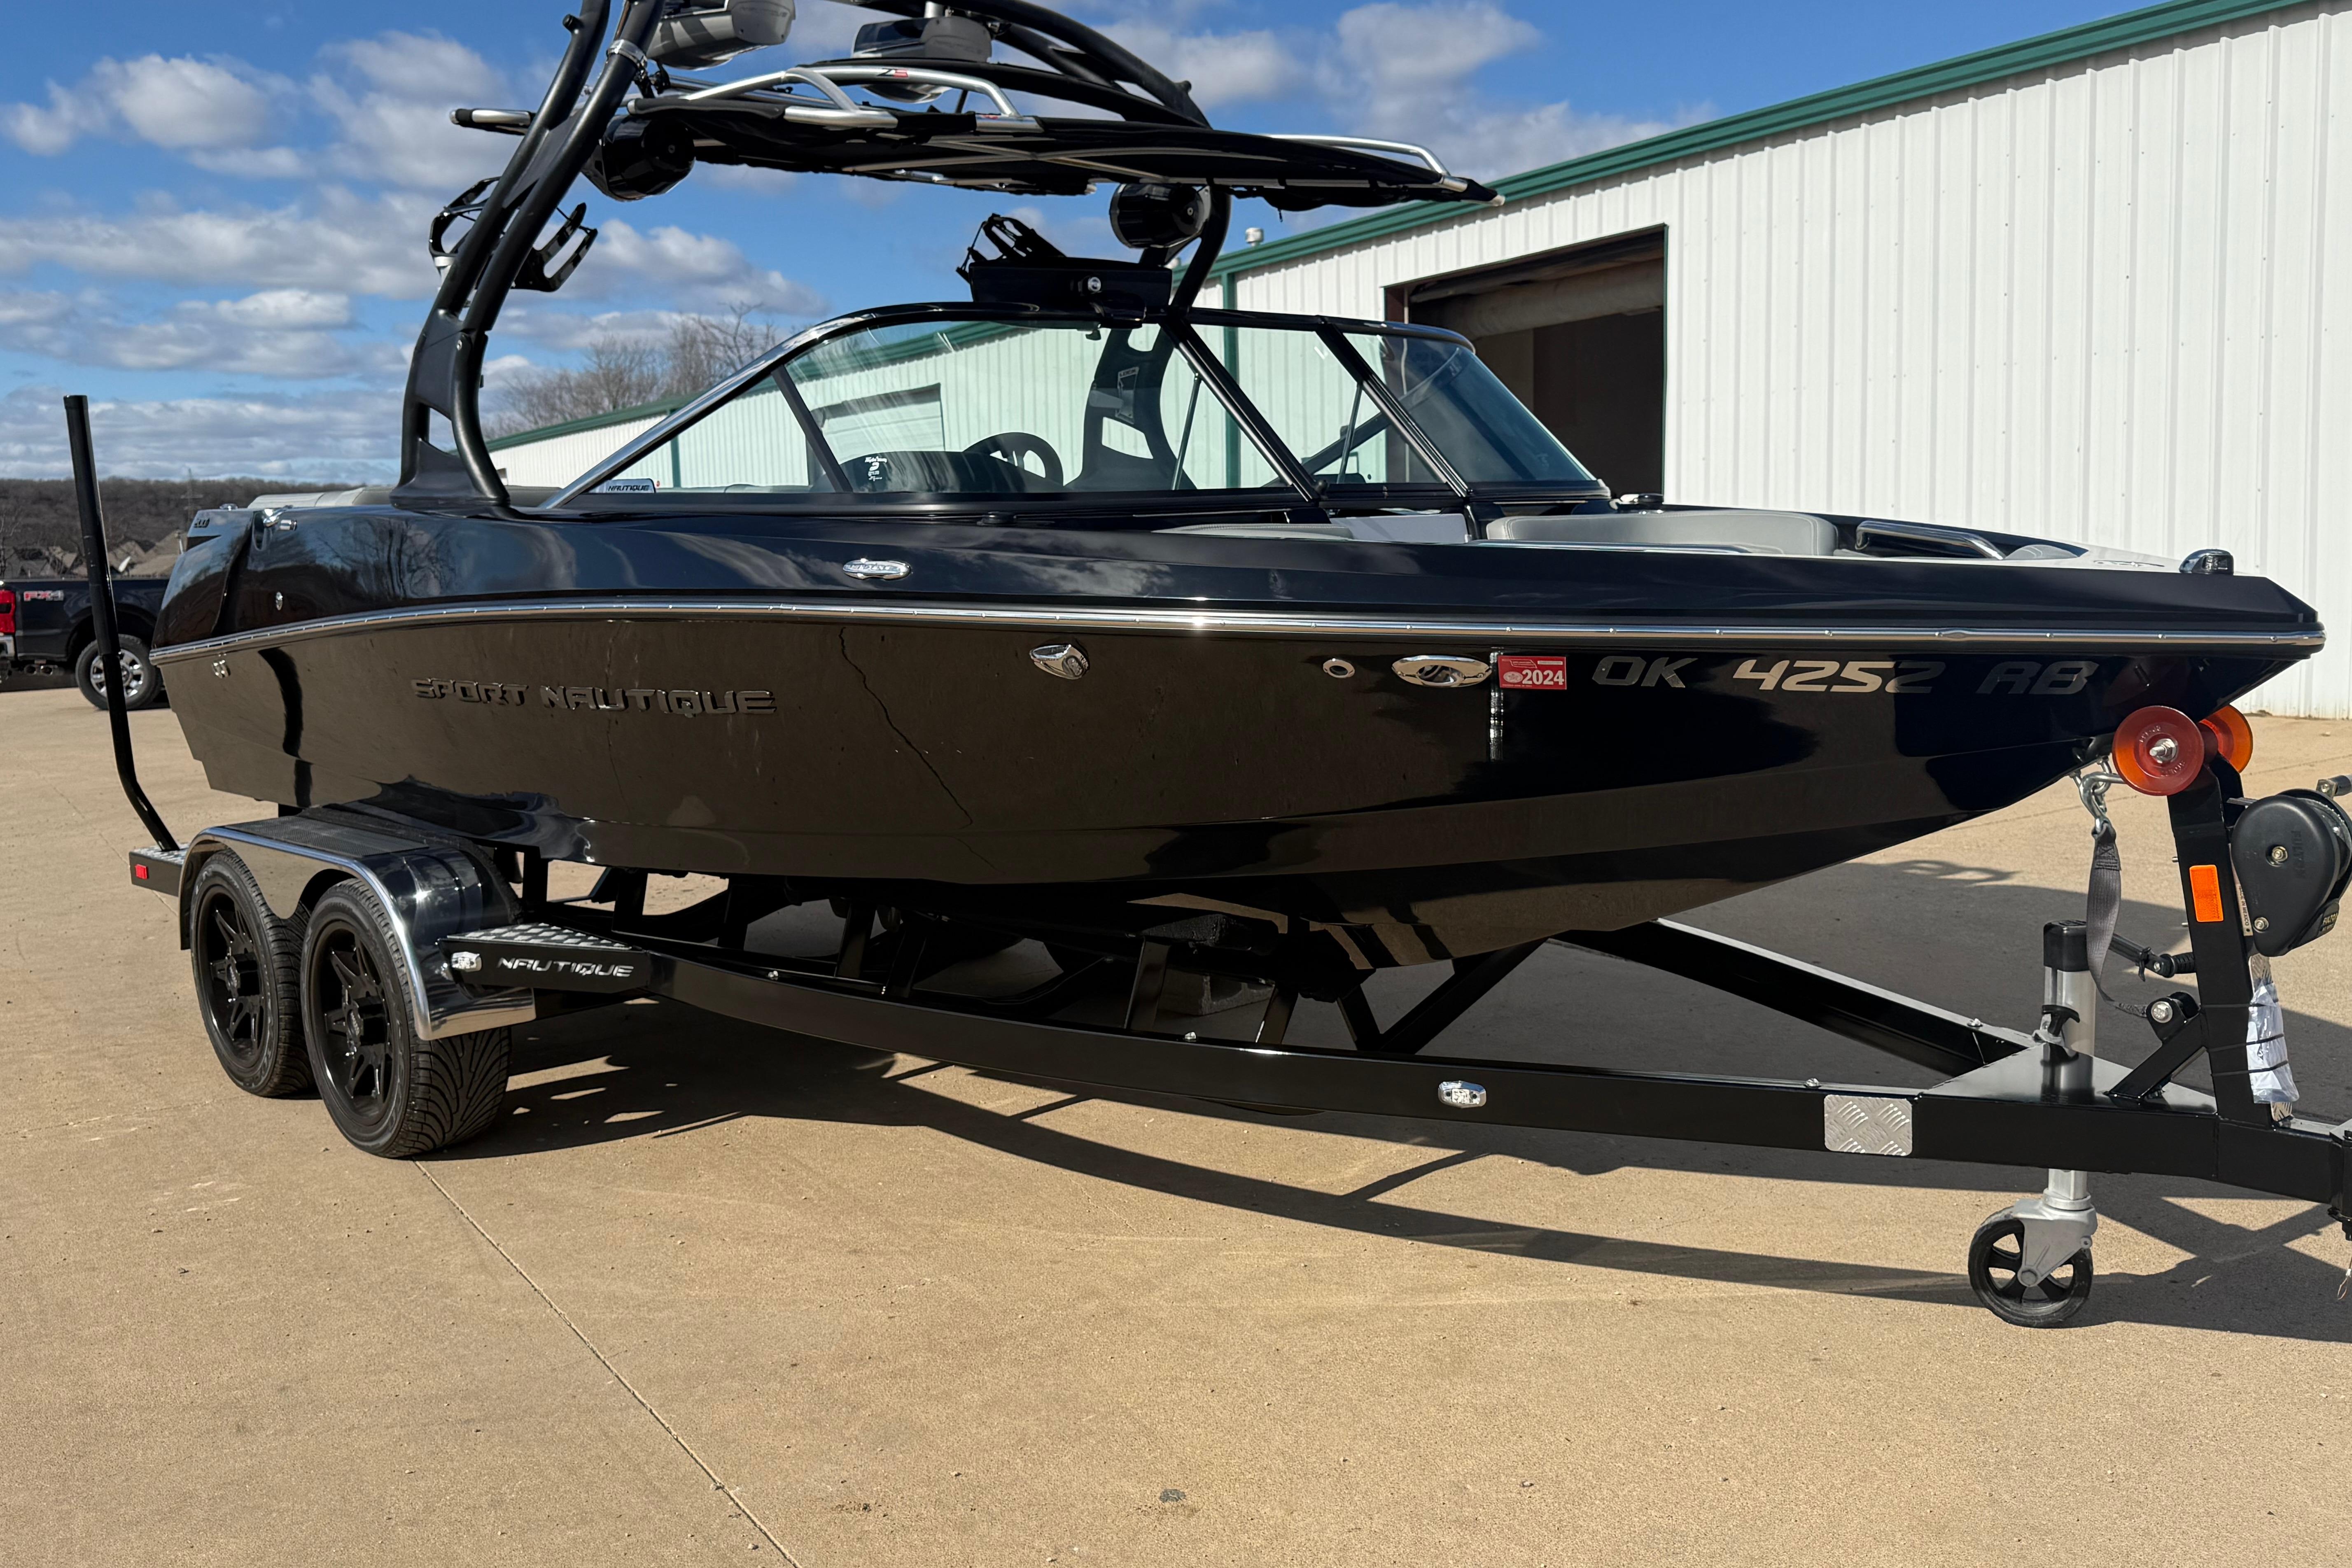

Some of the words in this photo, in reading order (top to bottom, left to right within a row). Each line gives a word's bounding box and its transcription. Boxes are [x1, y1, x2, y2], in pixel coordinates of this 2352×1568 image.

[23, 590, 64, 602] FX4
[1522, 669, 1564, 685] 2024
[1592, 656, 1698, 688] OK
[1733, 659, 1946, 693] 4252
[412, 678, 529, 706] SPORT
[540, 686, 777, 718] NAUTIQUE
[497, 957, 634, 977] NAUTIQUE
